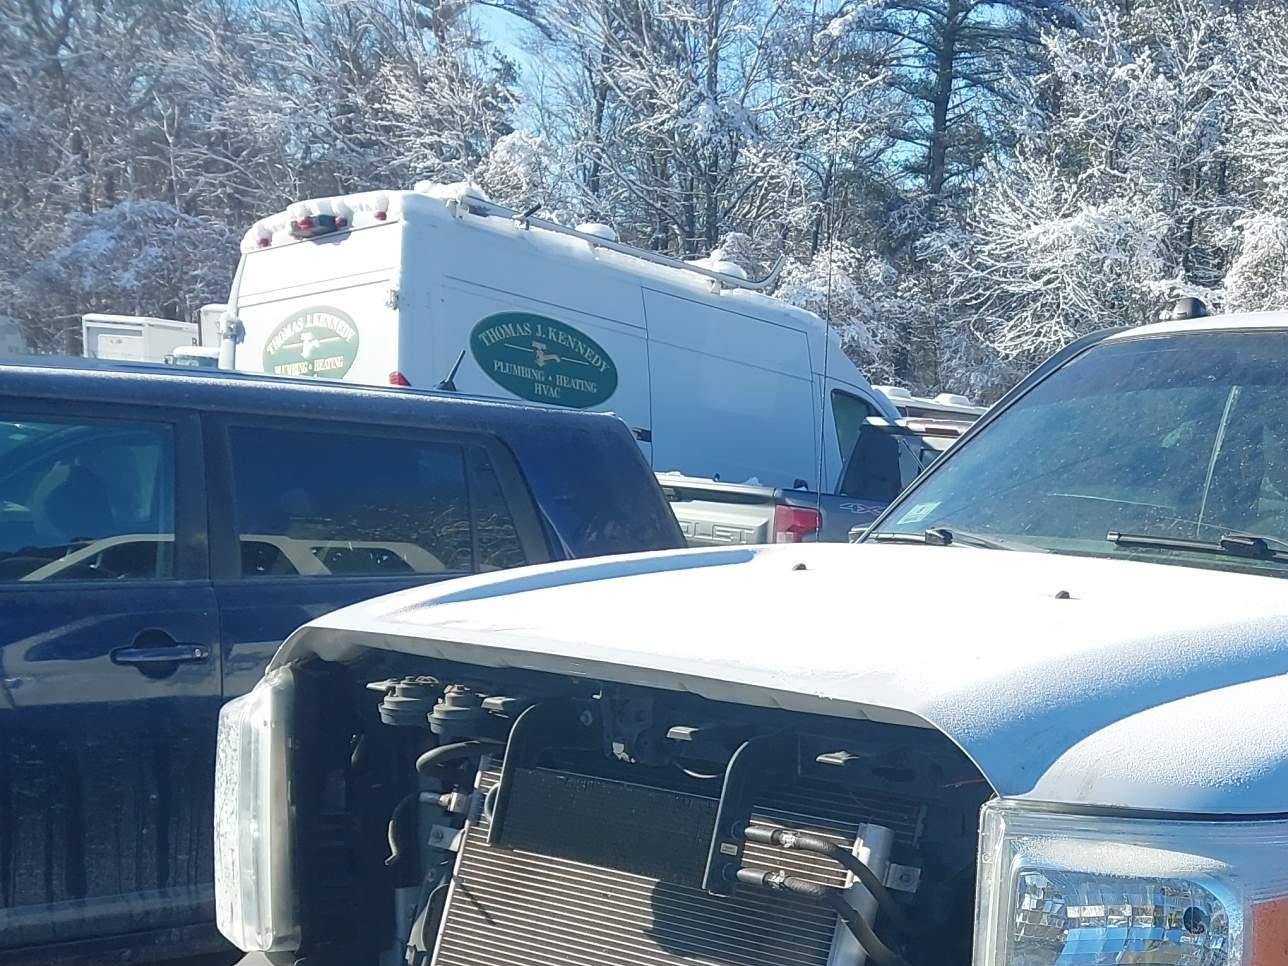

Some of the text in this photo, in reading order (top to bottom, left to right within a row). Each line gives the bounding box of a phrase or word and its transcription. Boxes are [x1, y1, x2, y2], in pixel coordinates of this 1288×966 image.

[478, 322, 610, 373] THOMAS J. KENNEDY
[493, 360, 597, 393] PLUMBING HEATING
[534, 383, 561, 399] HVAC
